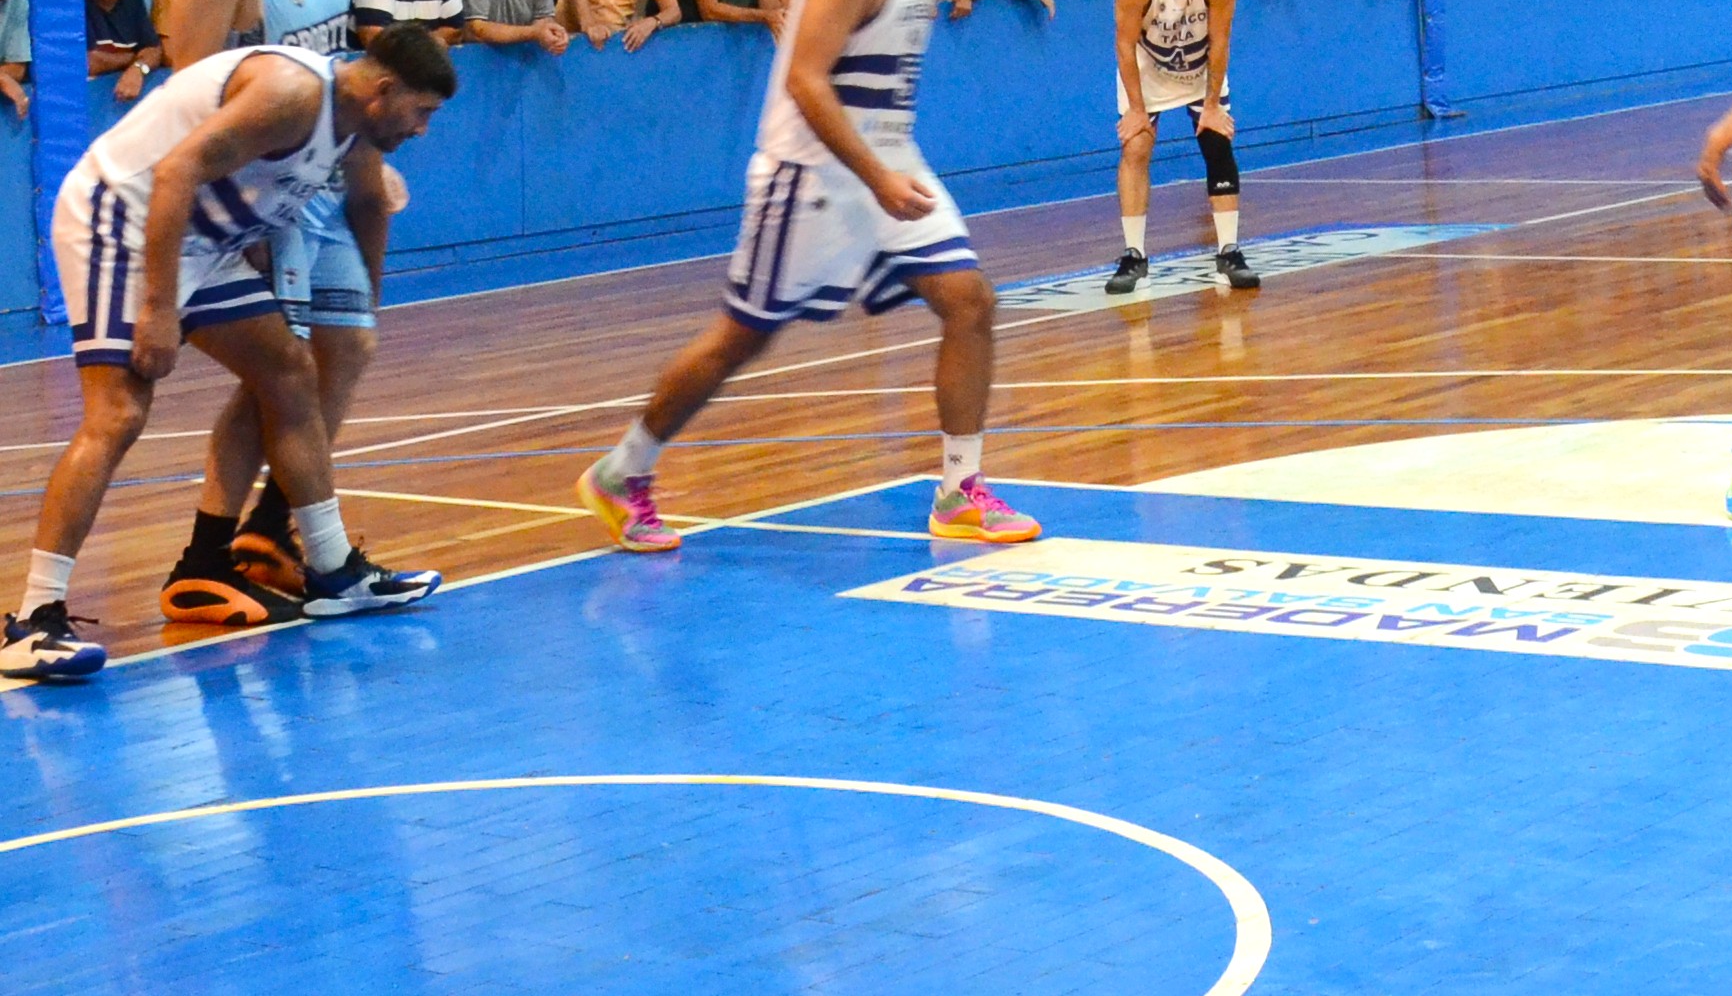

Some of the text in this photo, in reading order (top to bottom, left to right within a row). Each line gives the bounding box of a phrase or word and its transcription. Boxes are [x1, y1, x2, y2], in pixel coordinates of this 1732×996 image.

[901, 576, 1581, 644] MADERERA
[931, 565, 1615, 626] SAN SALVADOR
